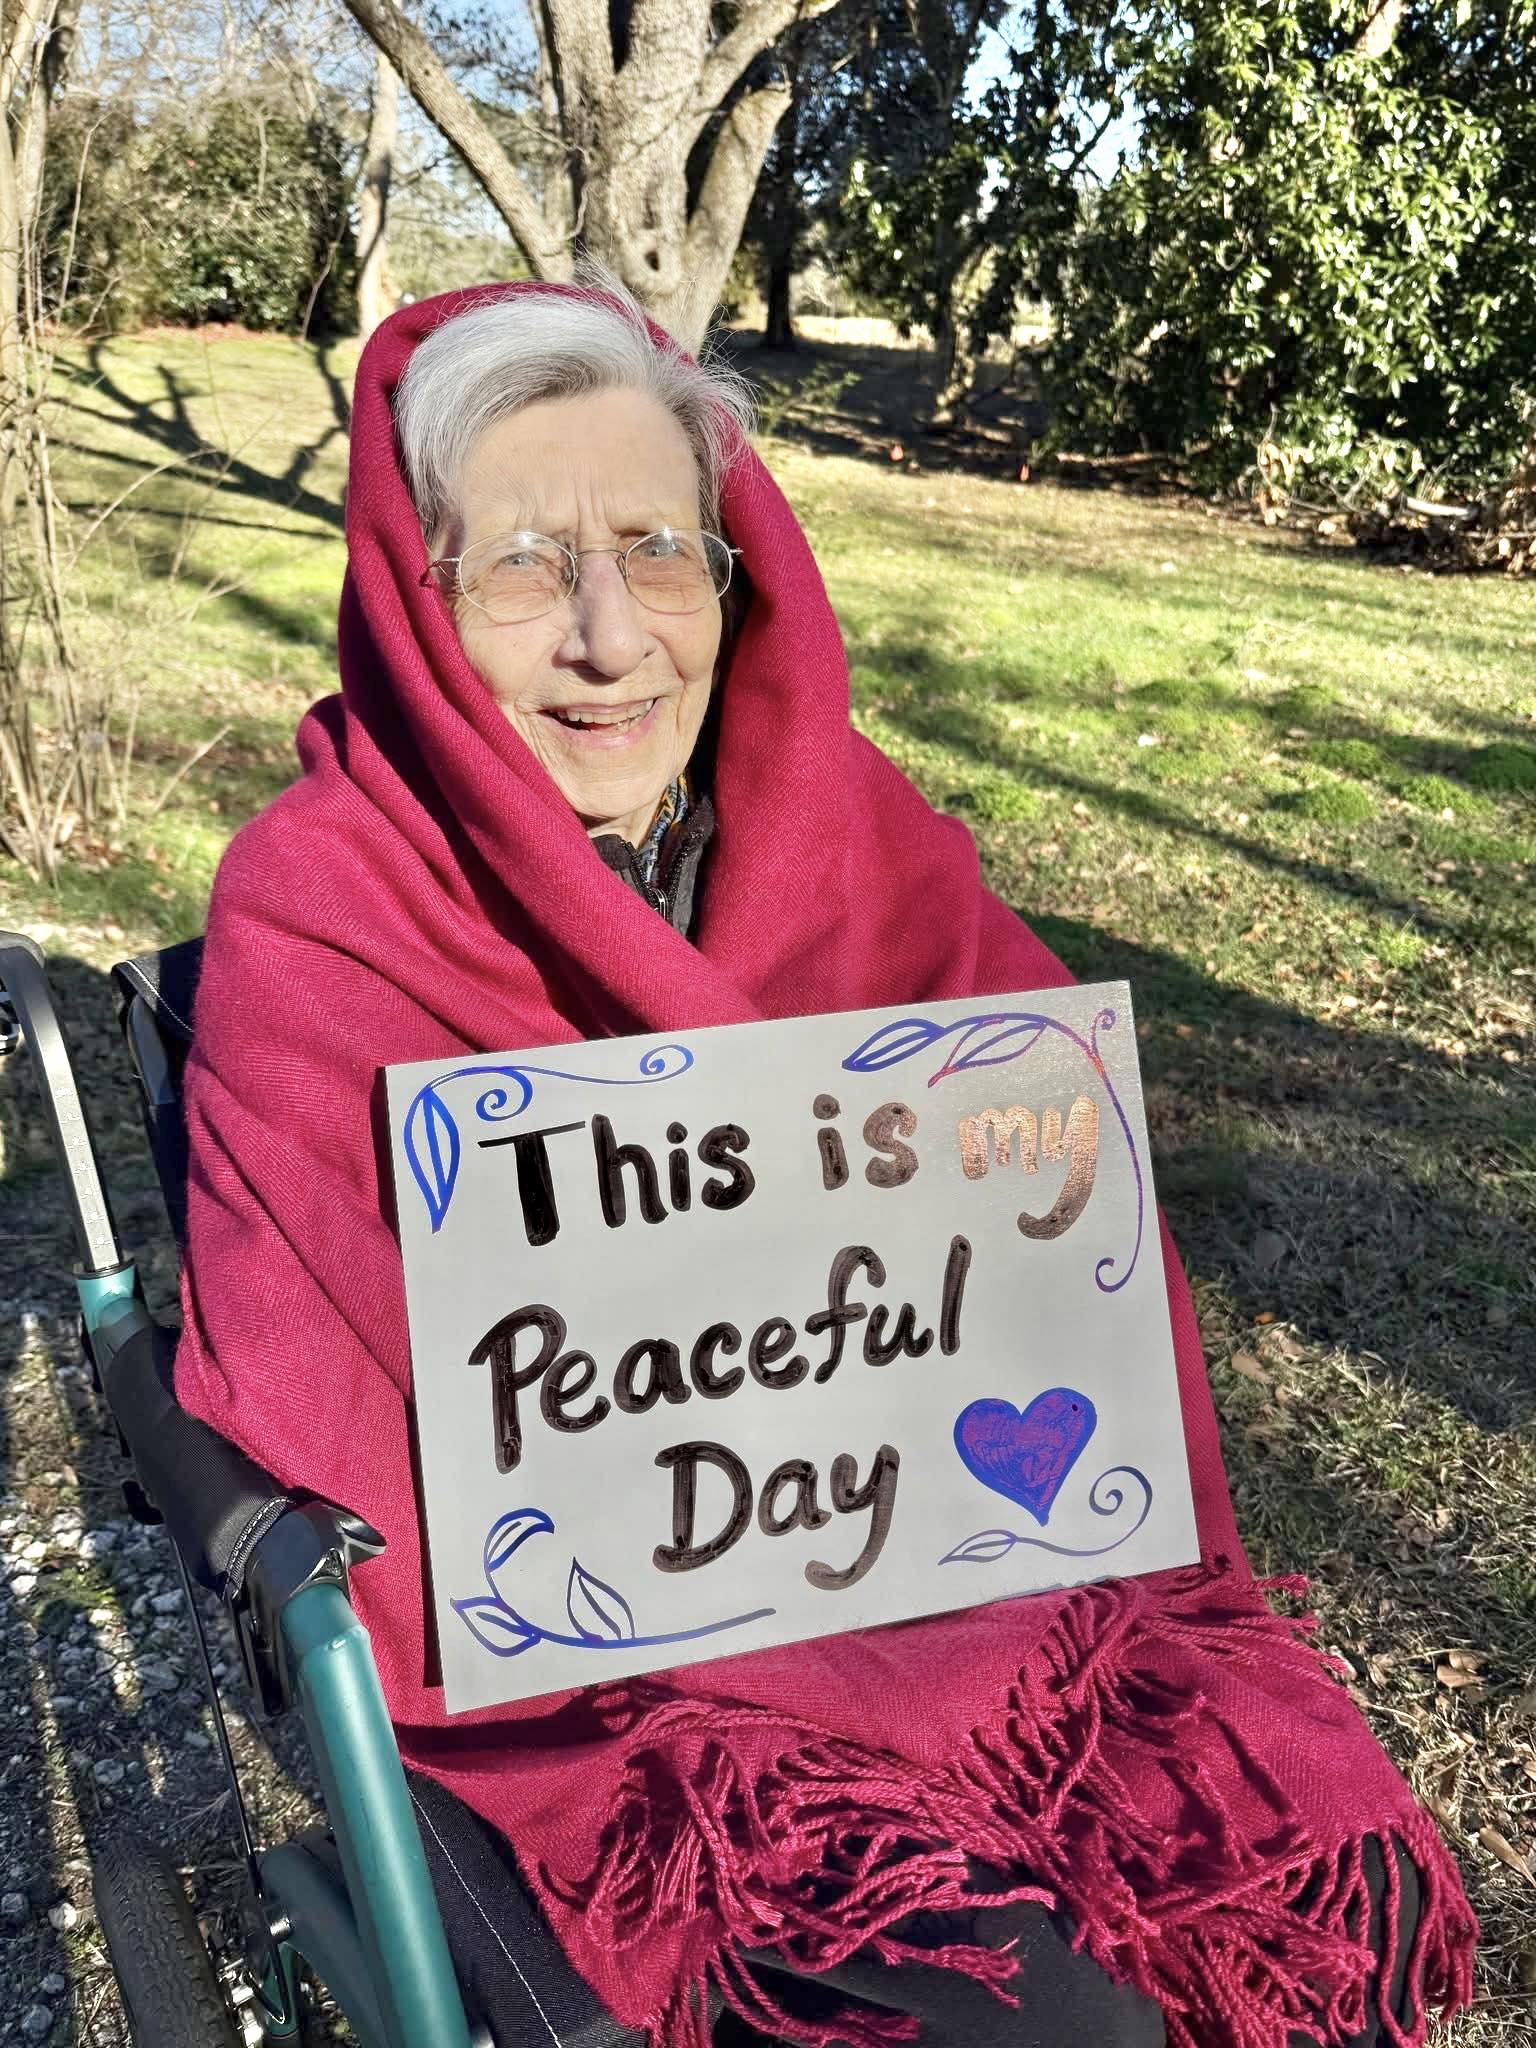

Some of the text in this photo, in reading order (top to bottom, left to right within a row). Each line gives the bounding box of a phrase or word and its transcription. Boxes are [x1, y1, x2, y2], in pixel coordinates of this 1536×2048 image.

[477, 1093, 1099, 1247] This is my
[467, 1235, 973, 1475] Peaceful
[652, 1441, 902, 1591] Day
